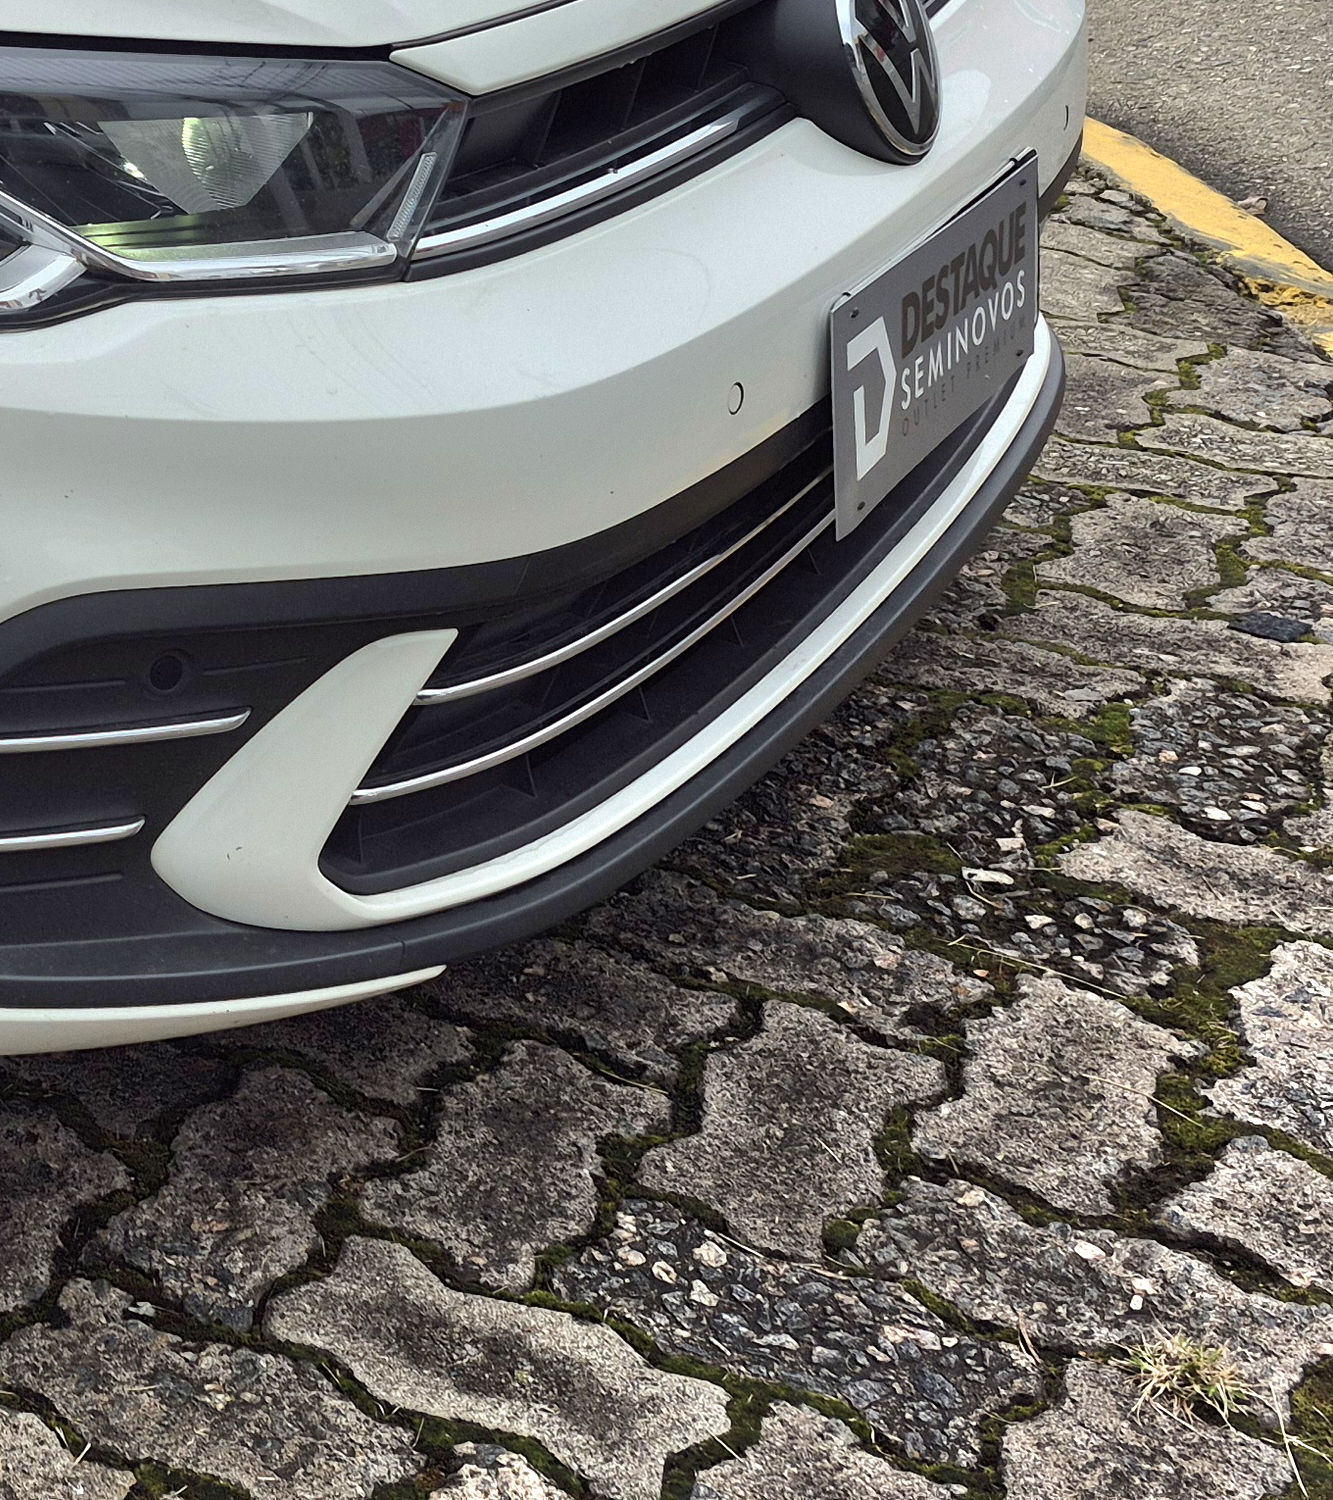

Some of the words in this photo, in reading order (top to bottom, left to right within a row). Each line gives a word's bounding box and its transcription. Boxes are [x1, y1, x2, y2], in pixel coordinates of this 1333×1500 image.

[900, 269, 1026, 410] SEMINOVOS
[901, 201, 1027, 360] DESTAQUE
[901, 374, 956, 438] OUTLET
[965, 315, 1027, 379] PREMIUM
